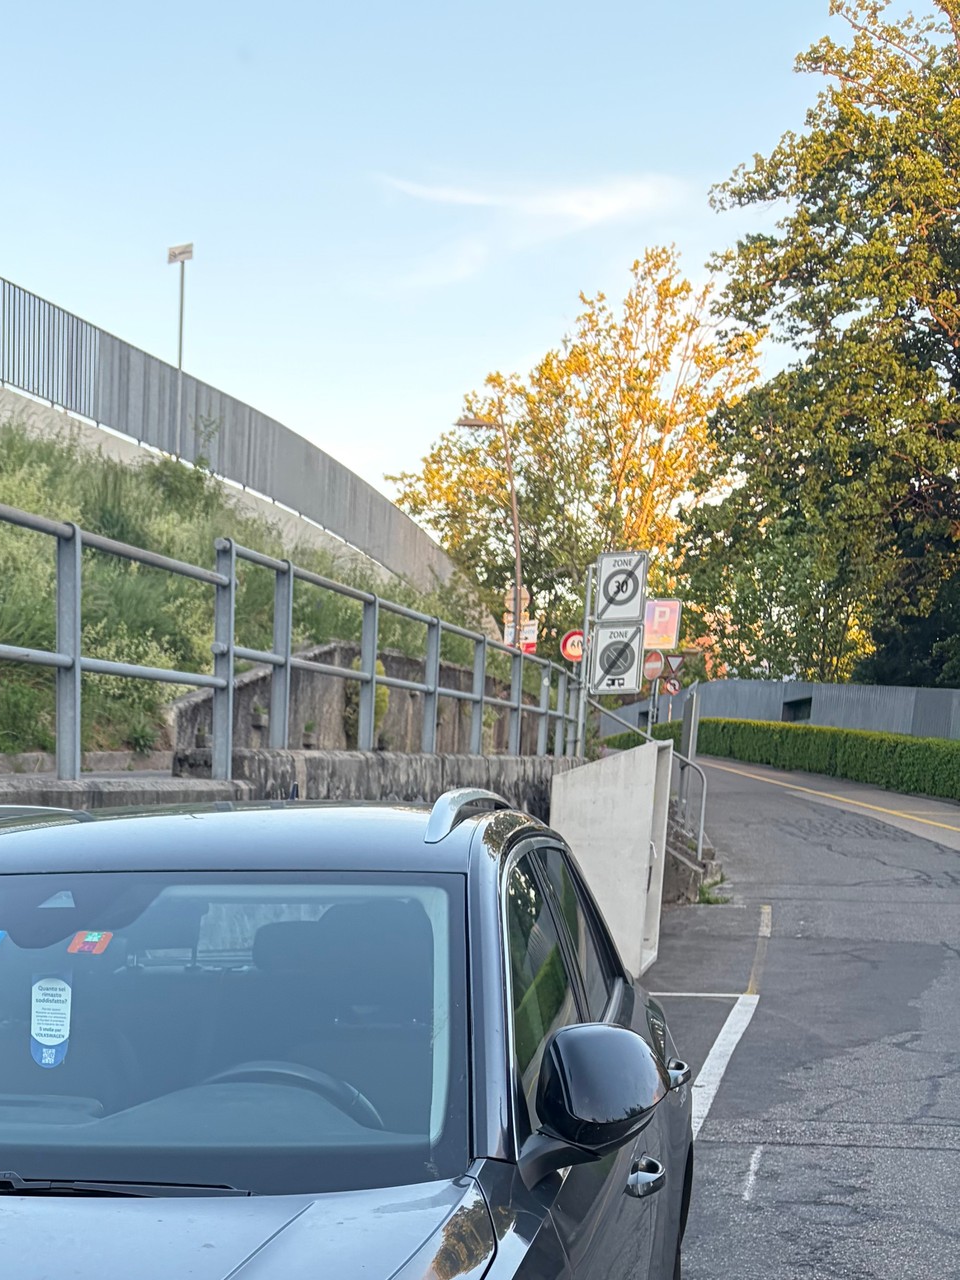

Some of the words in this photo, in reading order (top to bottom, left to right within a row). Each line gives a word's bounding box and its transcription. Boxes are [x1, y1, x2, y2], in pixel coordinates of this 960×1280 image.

[612, 560, 632, 568] ZONE
[613, 580, 629, 595] 30
[653, 606, 670, 631] P
[608, 631, 628, 639] ZONE
